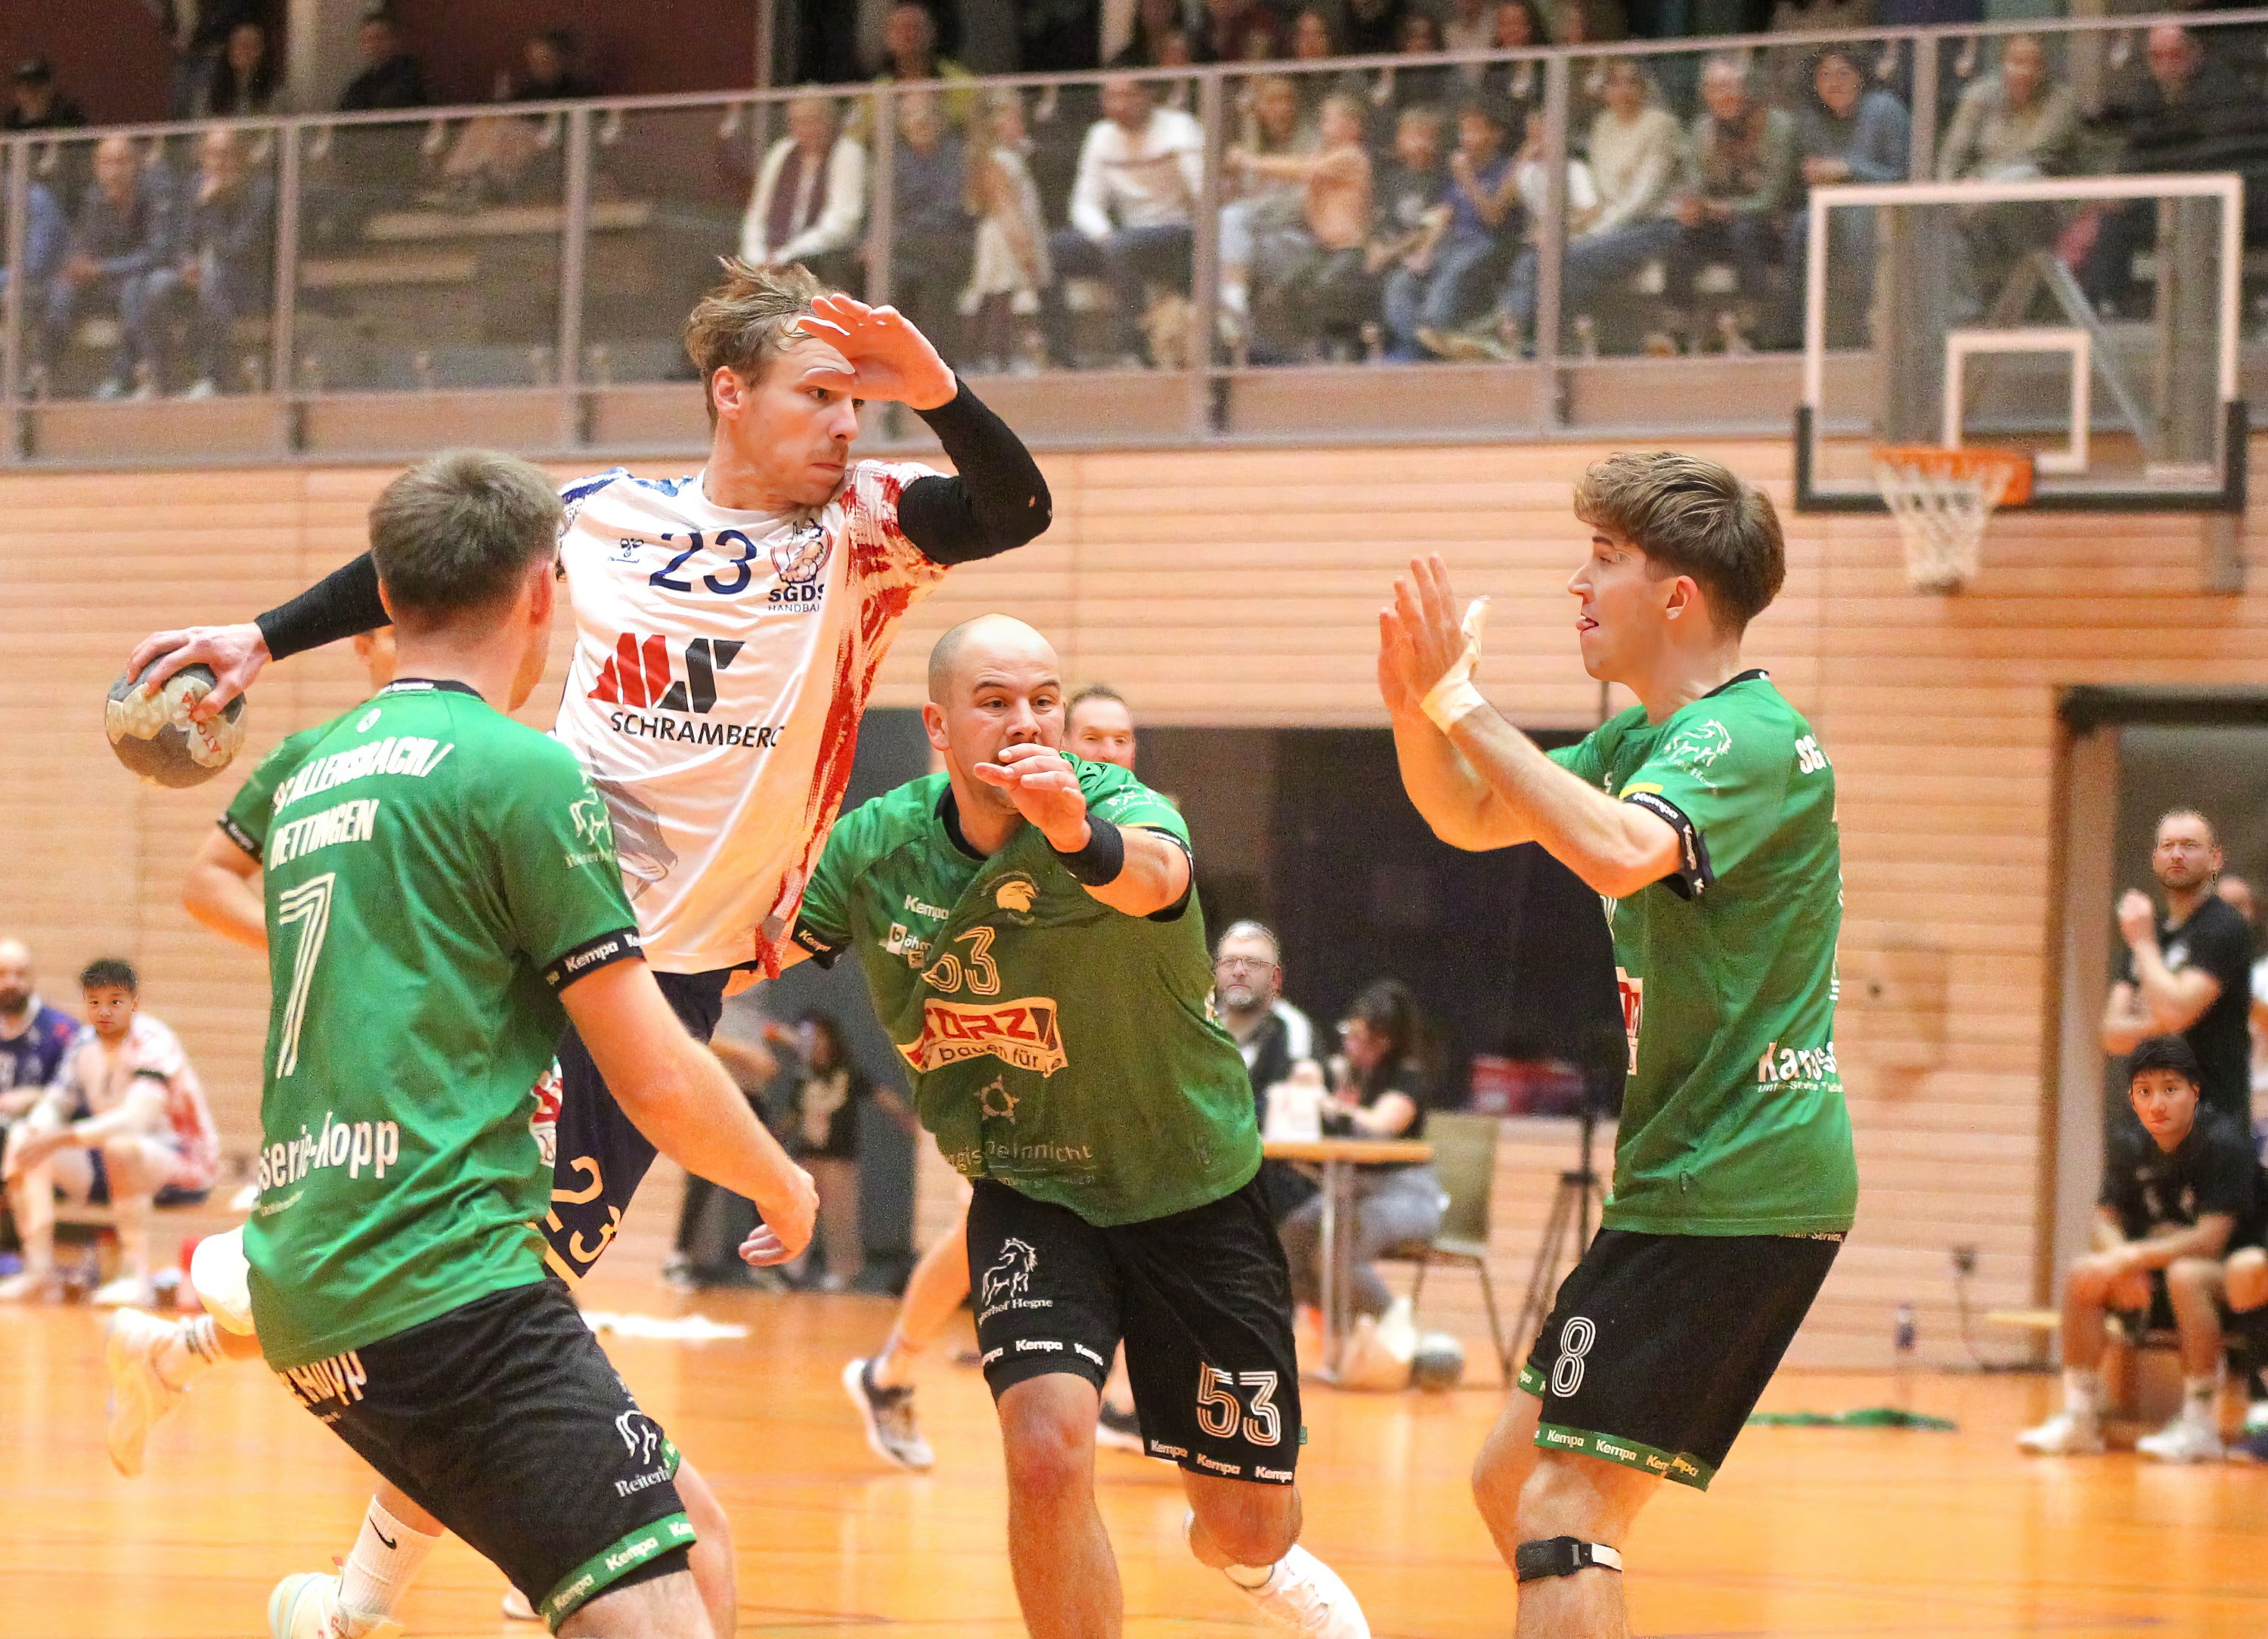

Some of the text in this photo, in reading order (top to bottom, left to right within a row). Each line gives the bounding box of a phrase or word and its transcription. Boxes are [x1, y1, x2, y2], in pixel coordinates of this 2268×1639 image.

[649, 529, 758, 595] 23
[903, 894, 950, 922] Kempa
[564, 941, 619, 973] Kempa
[276, 872, 336, 1079] 7
[1013, 1047, 1039, 1067] für
[1011, 1298, 1053, 1309] Hegne
[1015, 1339, 1063, 1352] Kempa
[1551, 1316, 1597, 1398] 8
[1197, 1362, 1281, 1447] 53
[1151, 1439, 1188, 1458] Kempa
[1197, 1453, 1241, 1475] Kempa
[1547, 1428, 1585, 1448] Kempa
[1596, 1439, 1637, 1461] Kempa
[605, 1537, 659, 1572] Kempa
